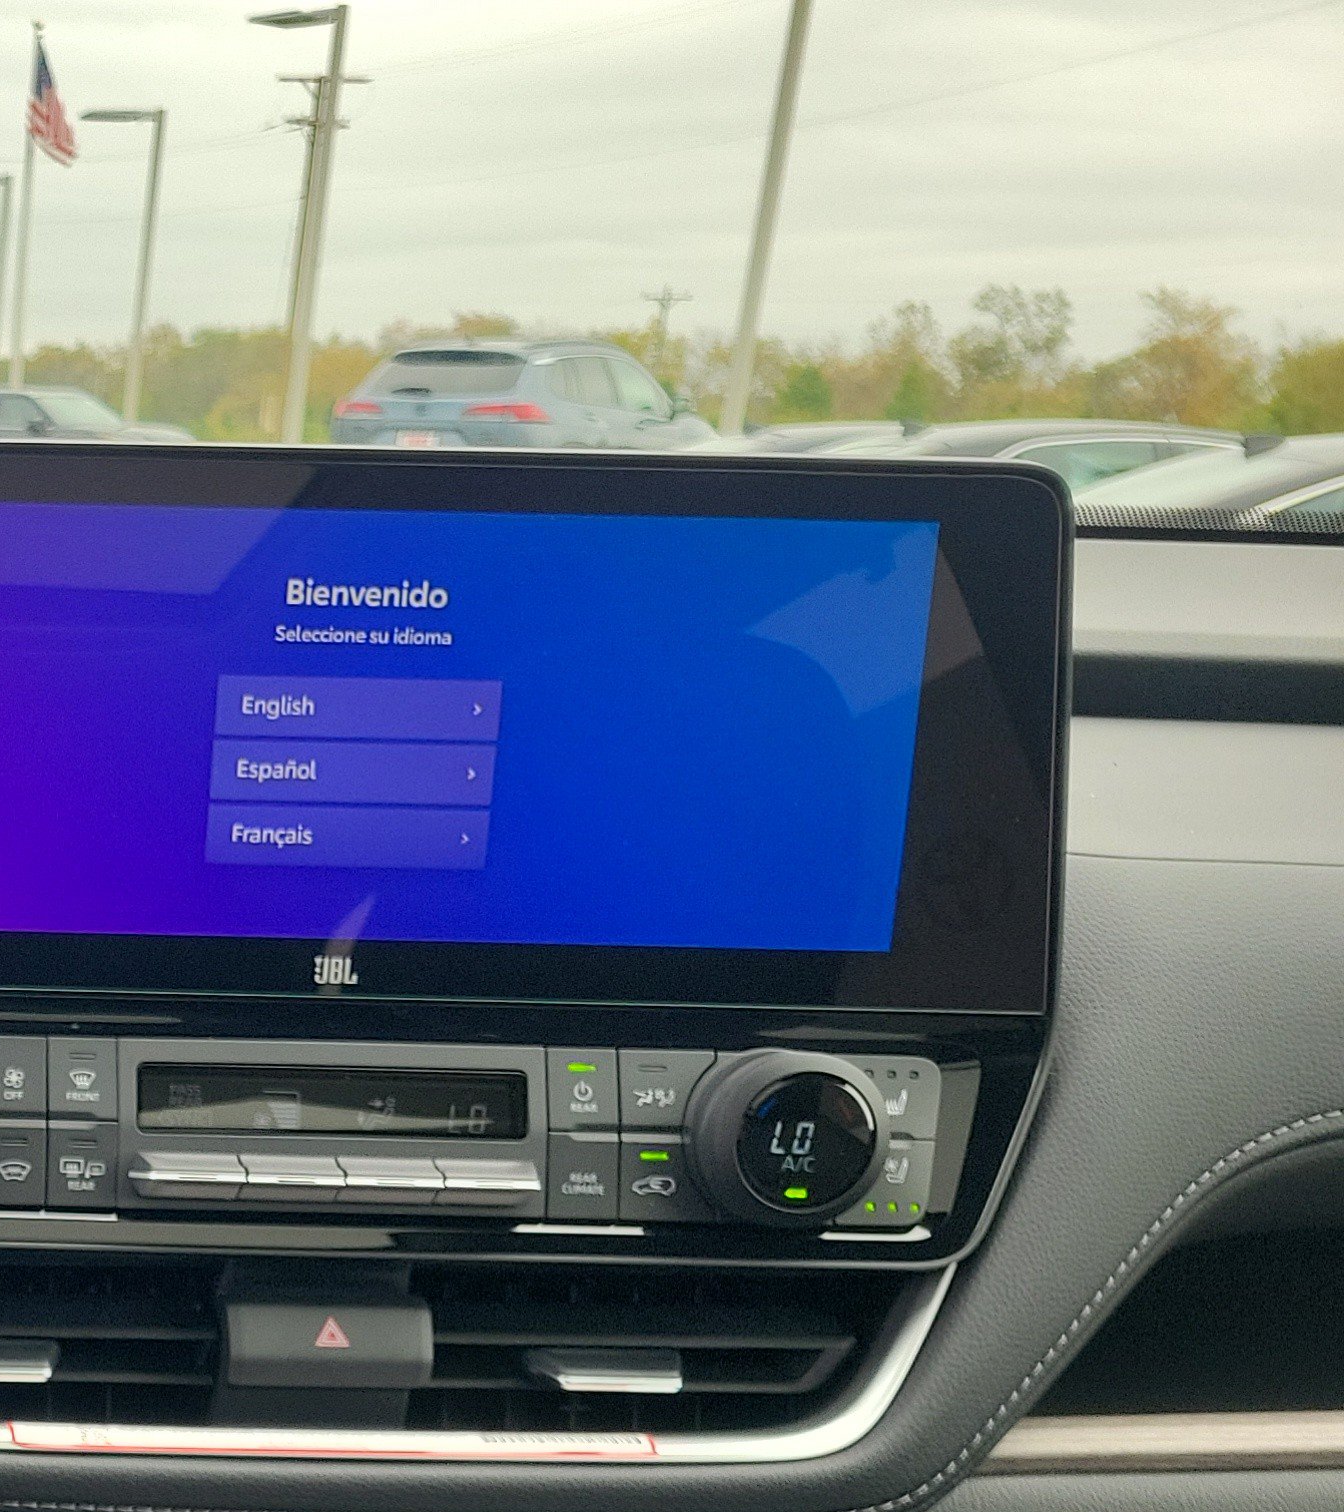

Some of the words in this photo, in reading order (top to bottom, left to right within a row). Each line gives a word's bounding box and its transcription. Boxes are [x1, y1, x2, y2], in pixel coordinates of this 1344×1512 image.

[285, 578, 449, 609] Bienvenido
[275, 625, 367, 645] Seleccione
[369, 630, 390, 645] su
[393, 628, 452, 646] idioma
[241, 694, 315, 720] English
[236, 757, 317, 783] Español
[231, 823, 313, 849] Français
[314, 954, 358, 985] JBL
[3, 1091, 24, 1100] OFF
[65, 1092, 100, 1101] FRONT
[570, 1103, 599, 1113] REAR
[781, 1155, 815, 1173] A/C
